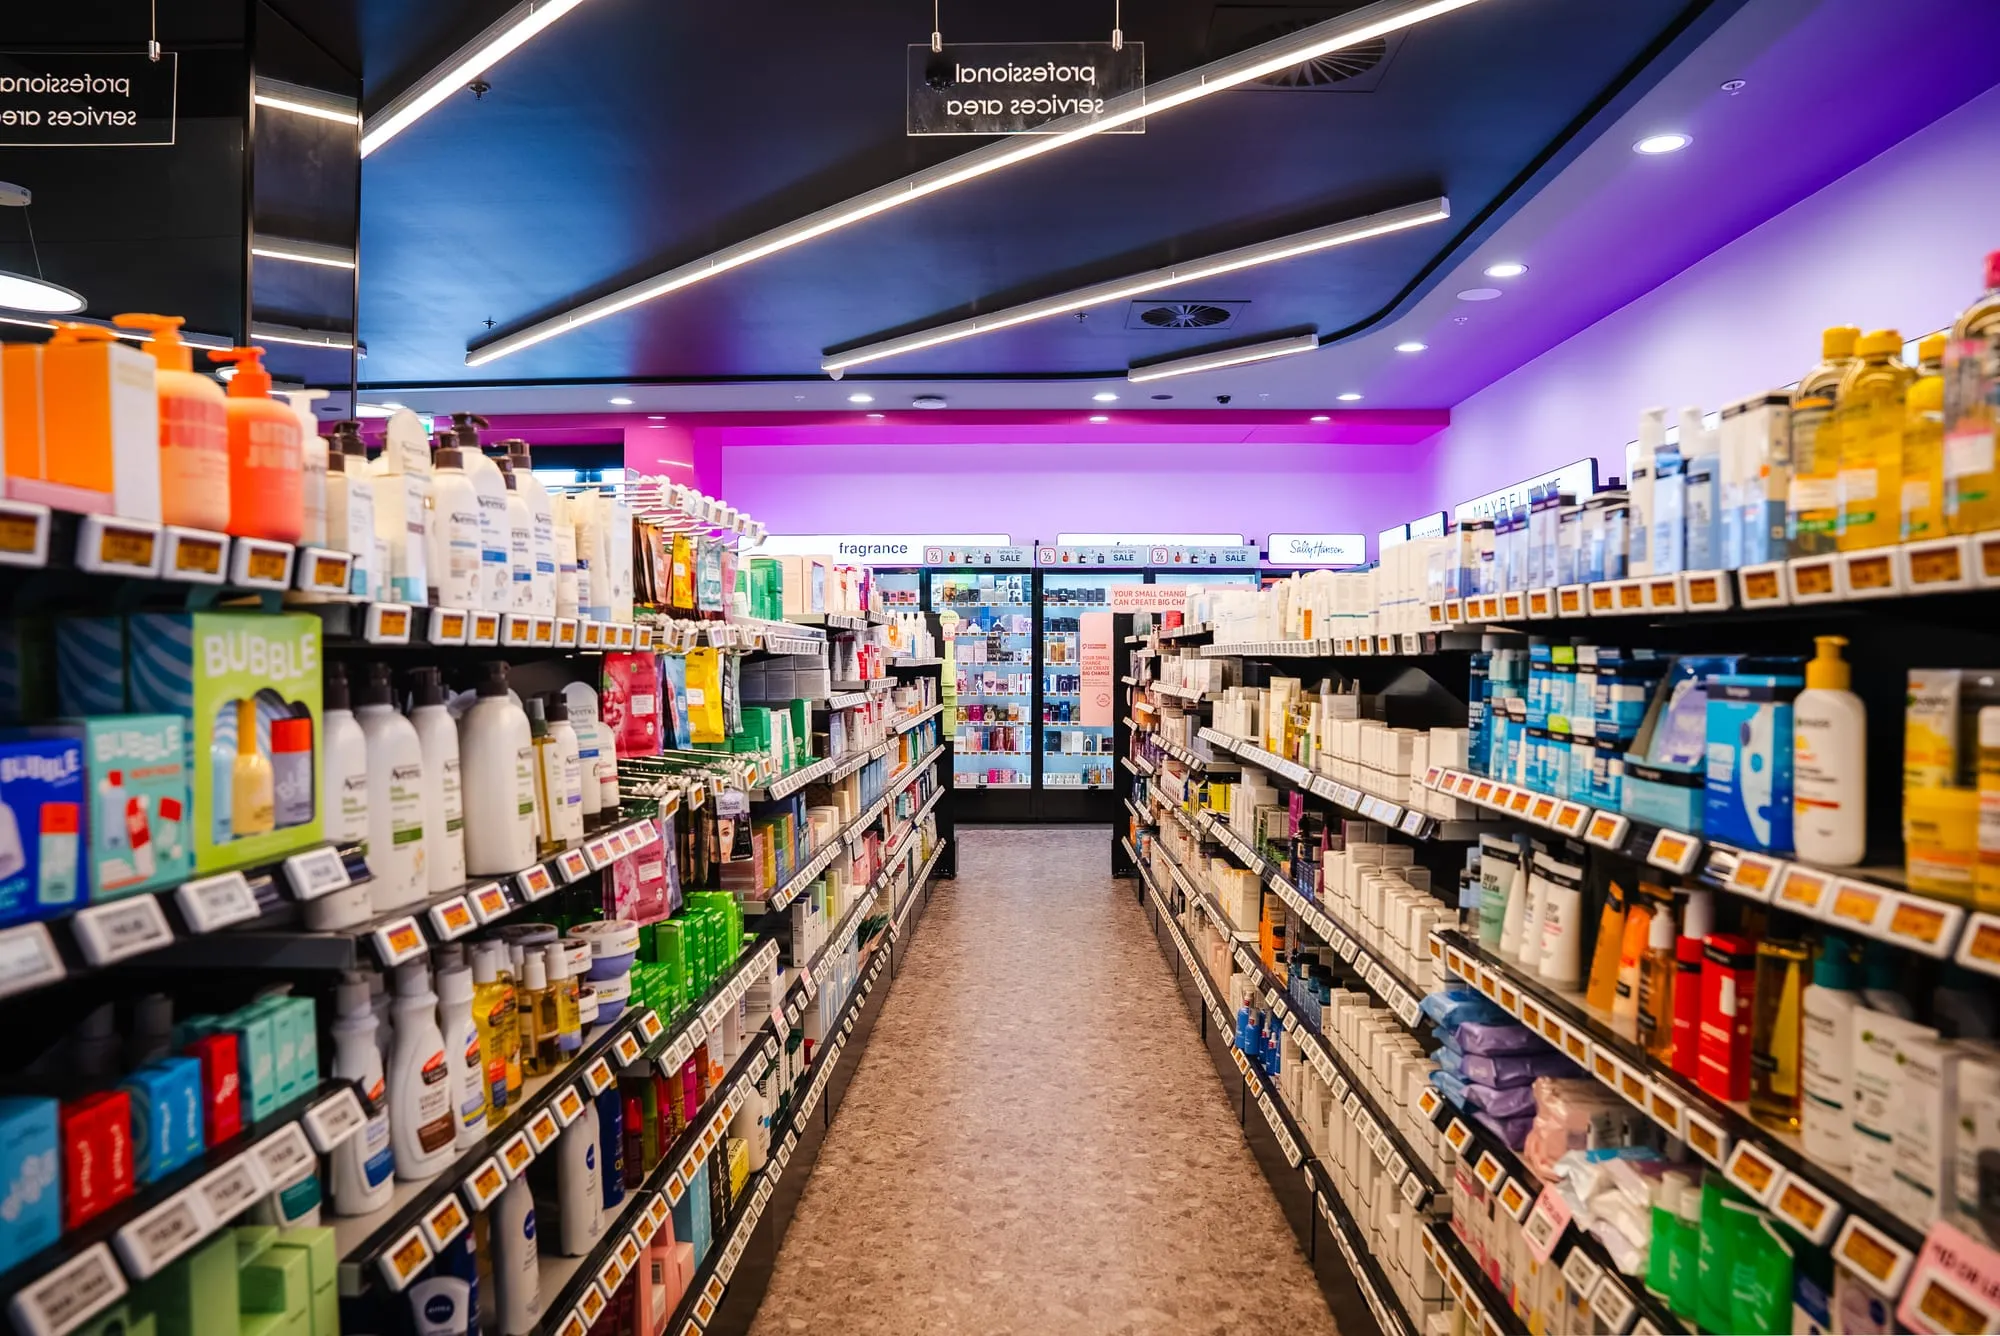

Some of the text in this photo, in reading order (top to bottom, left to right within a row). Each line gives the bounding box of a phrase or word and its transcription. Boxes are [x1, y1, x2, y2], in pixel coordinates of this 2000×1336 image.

[839, 542, 908, 557] fragrance
[1290, 540, 1344, 558] Sally Hansen
[203, 629, 317, 681] BUBBLE
[93, 725, 182, 763] BUBBLE
